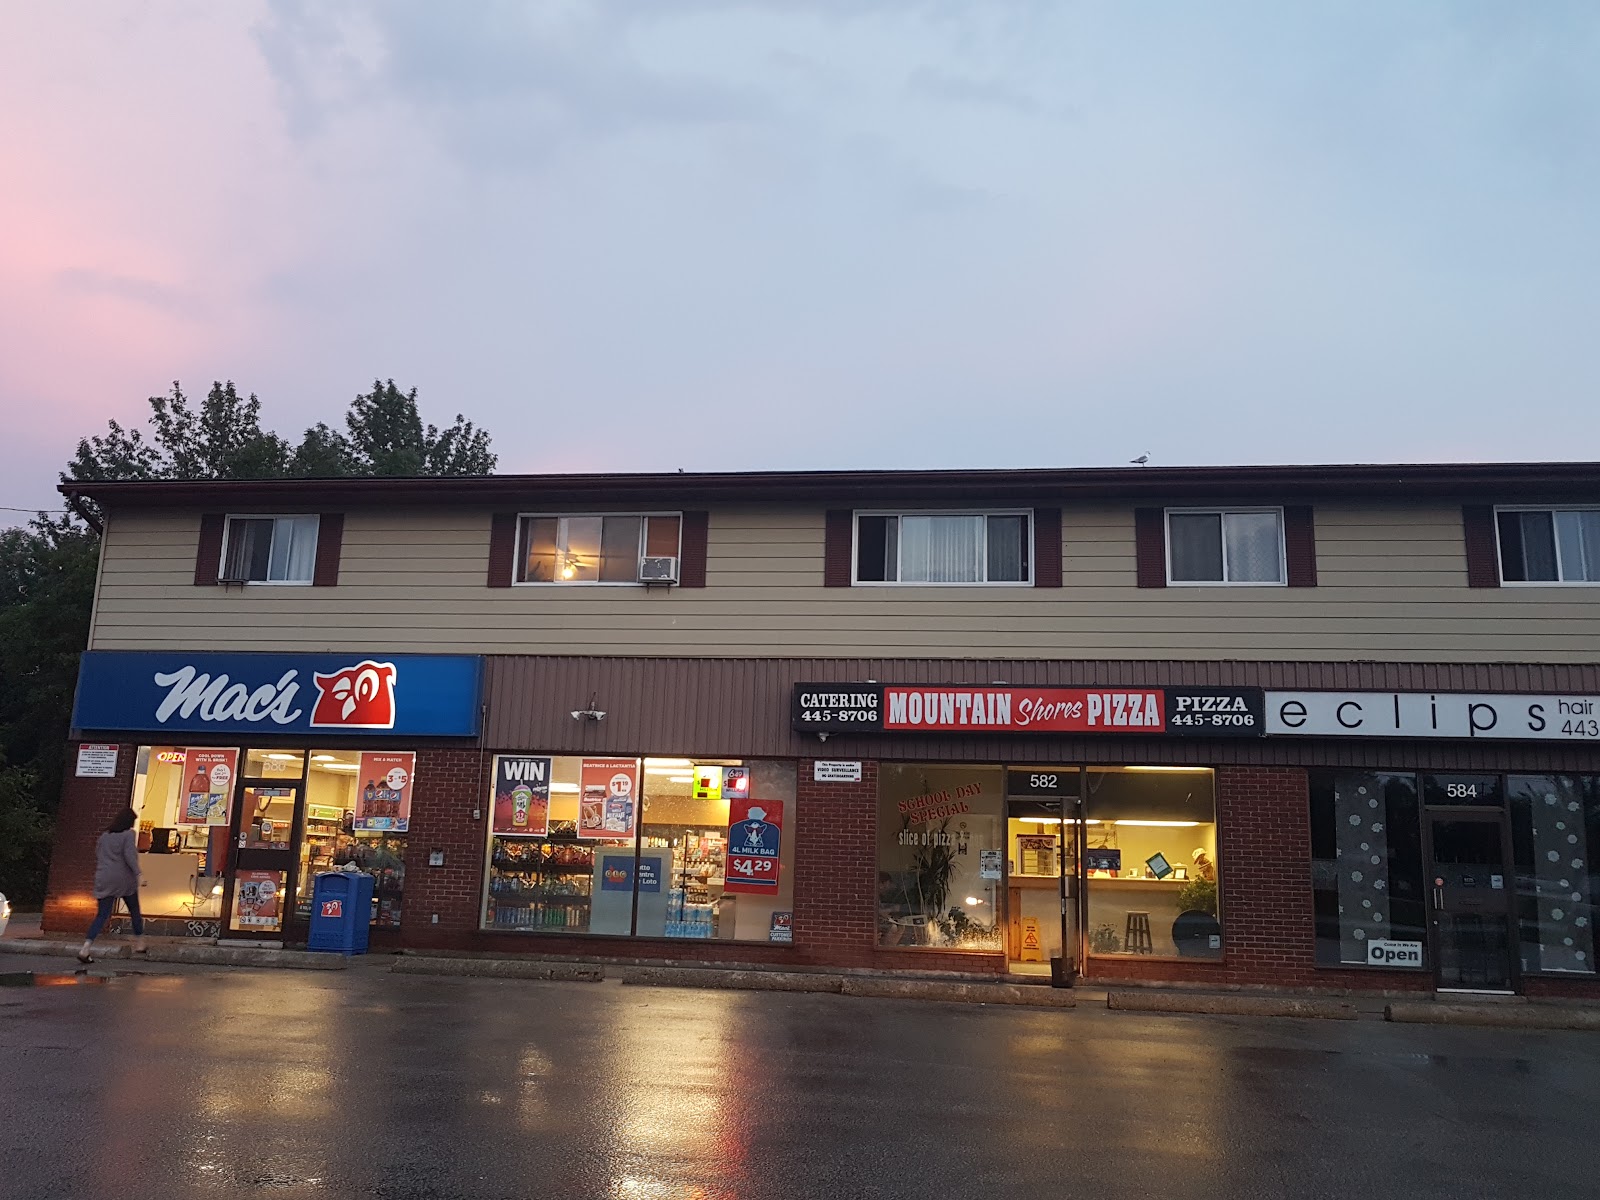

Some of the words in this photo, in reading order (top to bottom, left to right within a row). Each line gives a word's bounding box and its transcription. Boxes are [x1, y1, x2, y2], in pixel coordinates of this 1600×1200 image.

[154, 665, 302, 724] Mac's
[800, 693, 878, 708] CATERING
[889, 692, 1011, 725] MOUNTAIN
[1014, 697, 1083, 726] Shores
[1087, 693, 1160, 726] PIZZA
[1175, 696, 1249, 712] PIZZA
[1558, 698, 1594, 715] hair
[801, 710, 878, 722] 445-8706
[1171, 714, 1254, 726] 445-8706
[1561, 719, 1599, 737] 443
[159, 751, 186, 763] OPEN
[504, 761, 545, 781] WIN
[1030, 774, 1058, 788] 582
[898, 790, 952, 812] SCHOOL
[955, 782, 982, 799] DAY
[1447, 784, 1477, 798] 584
[910, 802, 969, 825] SPECIAL
[898, 828, 918, 846] slice
[922, 830, 930, 846] of
[1371, 946, 1418, 962] Open
